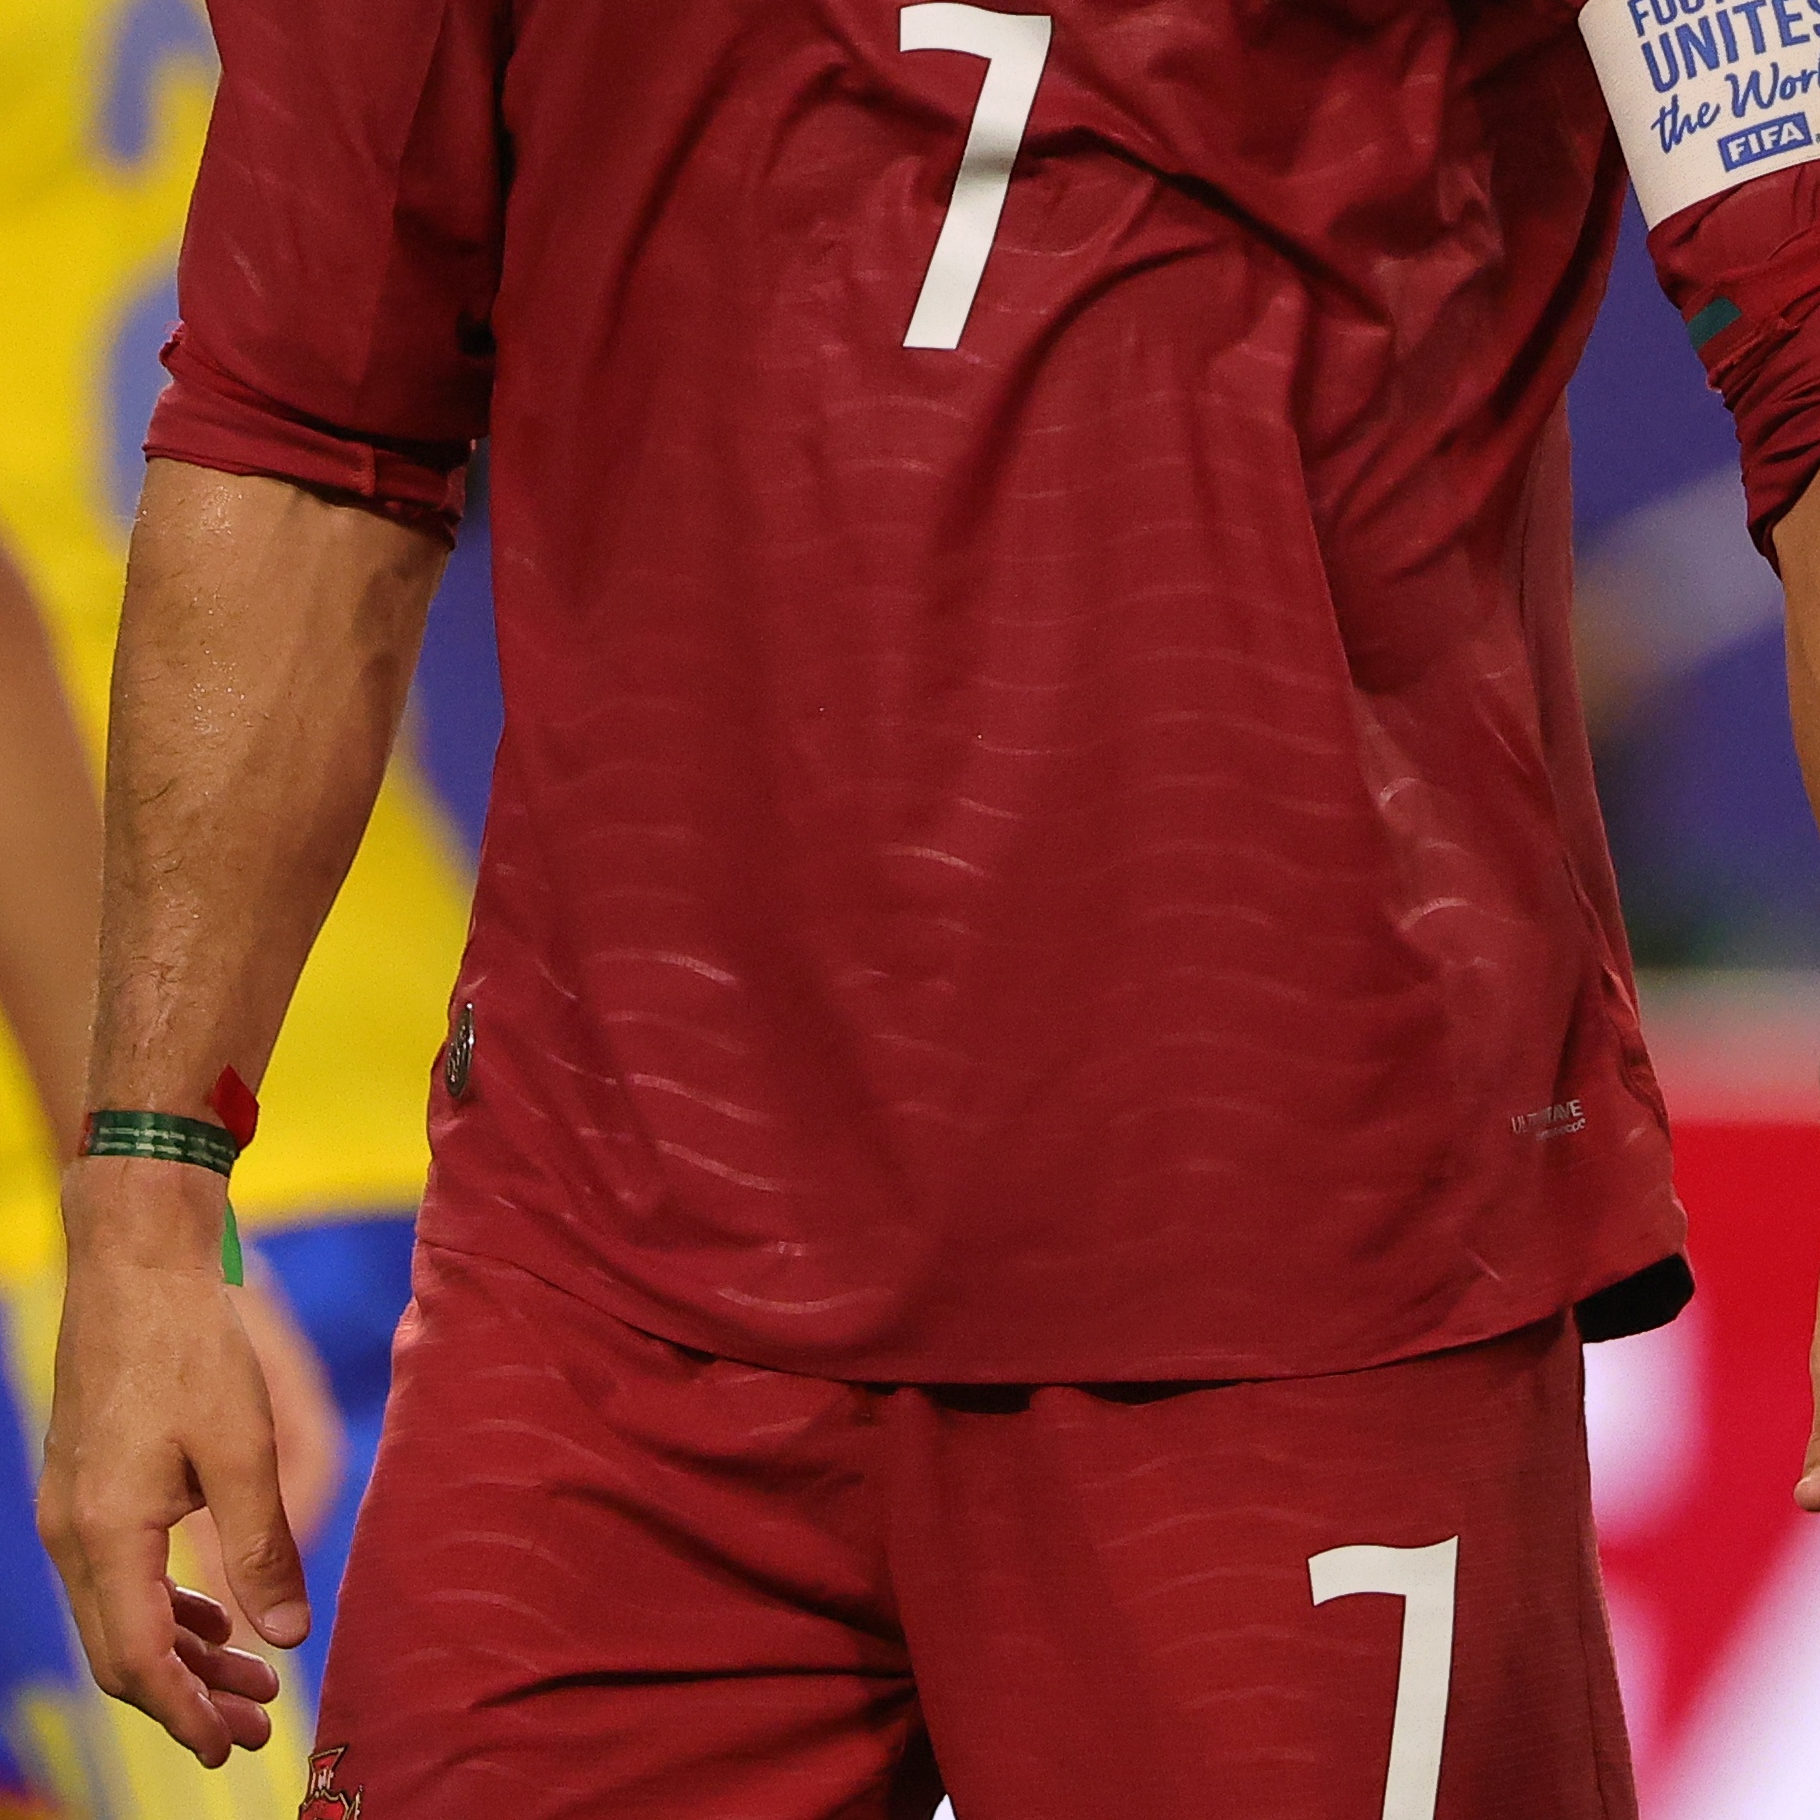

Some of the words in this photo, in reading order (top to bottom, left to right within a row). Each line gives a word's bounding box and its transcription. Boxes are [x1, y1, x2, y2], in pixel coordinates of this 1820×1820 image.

[900, 1, 1052, 349] 7
[1650, 94, 1720, 153] the
[1727, 124, 1807, 164] FIFA
[1307, 1534, 1459, 1820] 7
